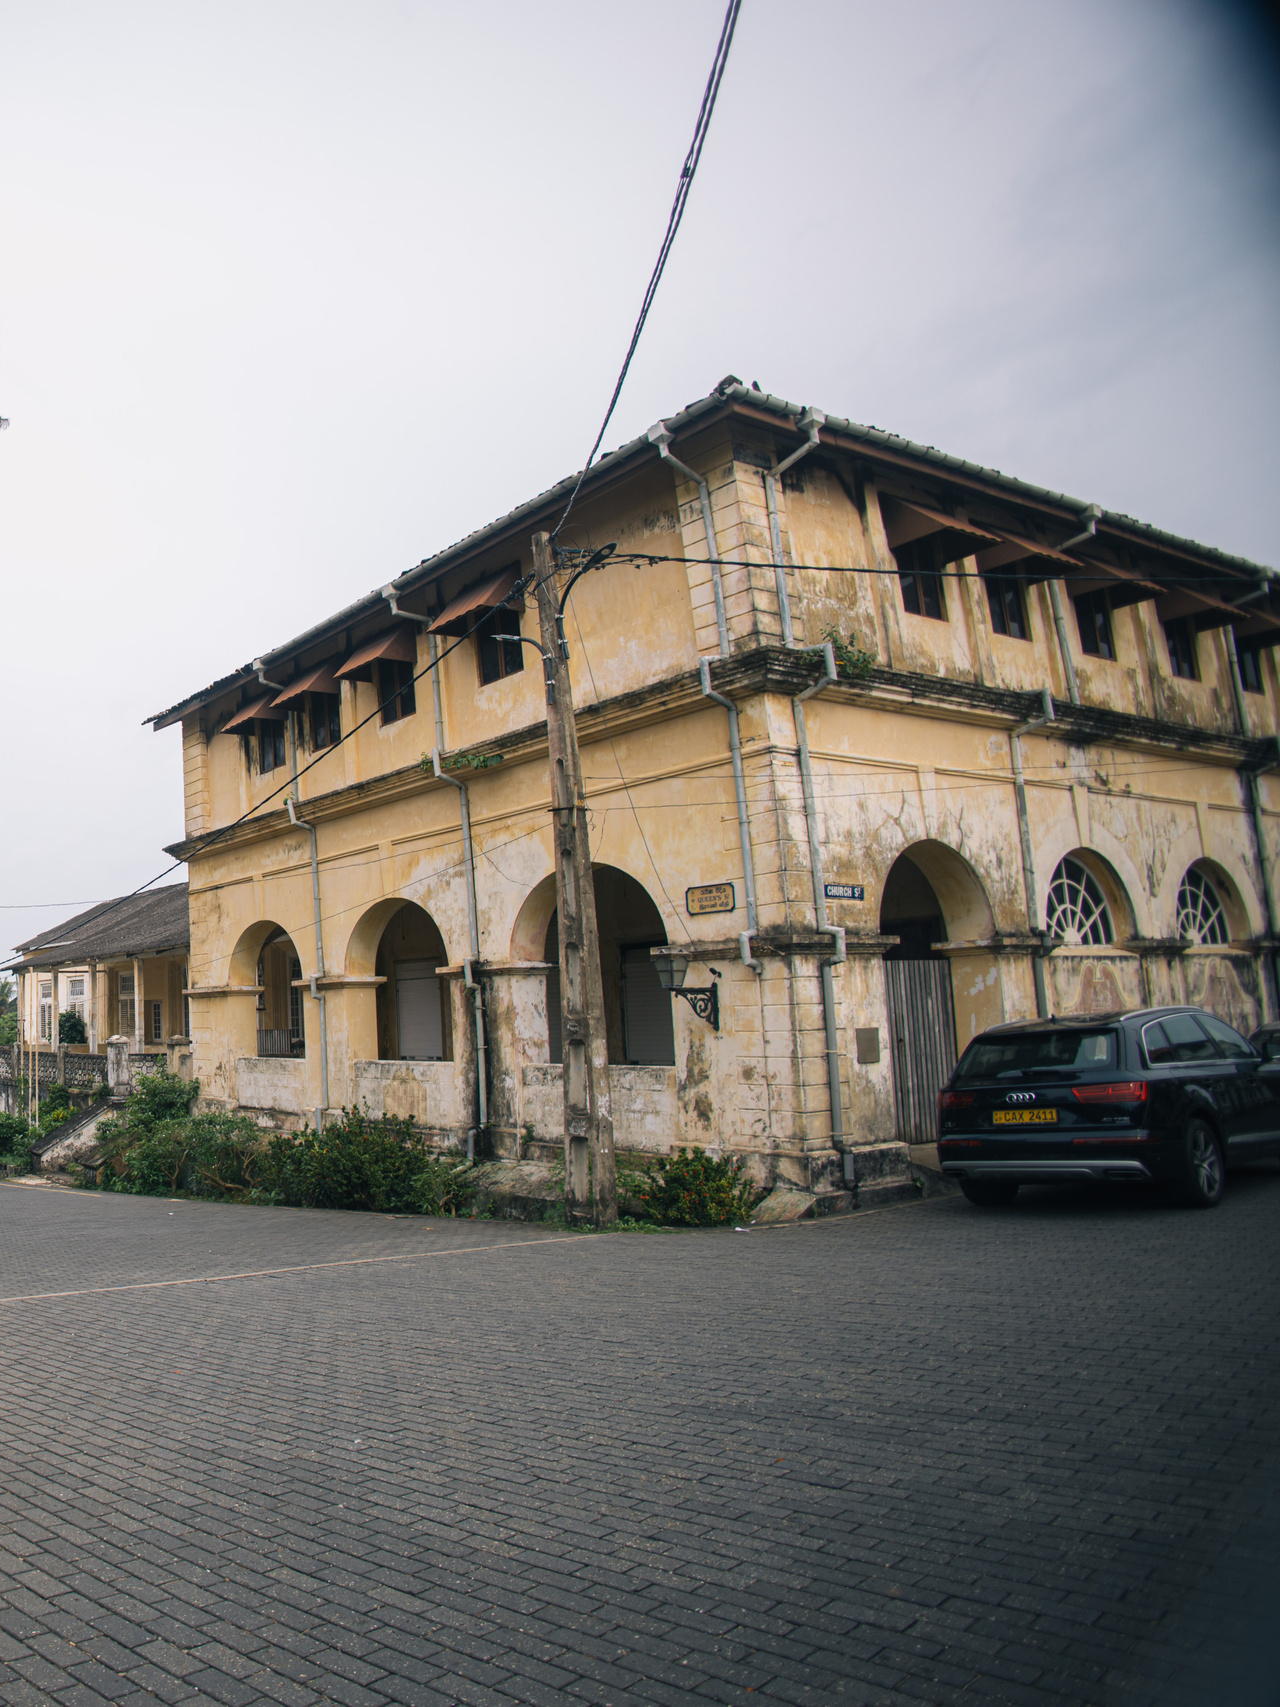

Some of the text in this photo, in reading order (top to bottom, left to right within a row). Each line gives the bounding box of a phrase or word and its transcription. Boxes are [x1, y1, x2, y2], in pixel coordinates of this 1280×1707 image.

[827, 885, 852, 897] CHURCH
[1004, 1110, 1055, 1122] CAX 2411
